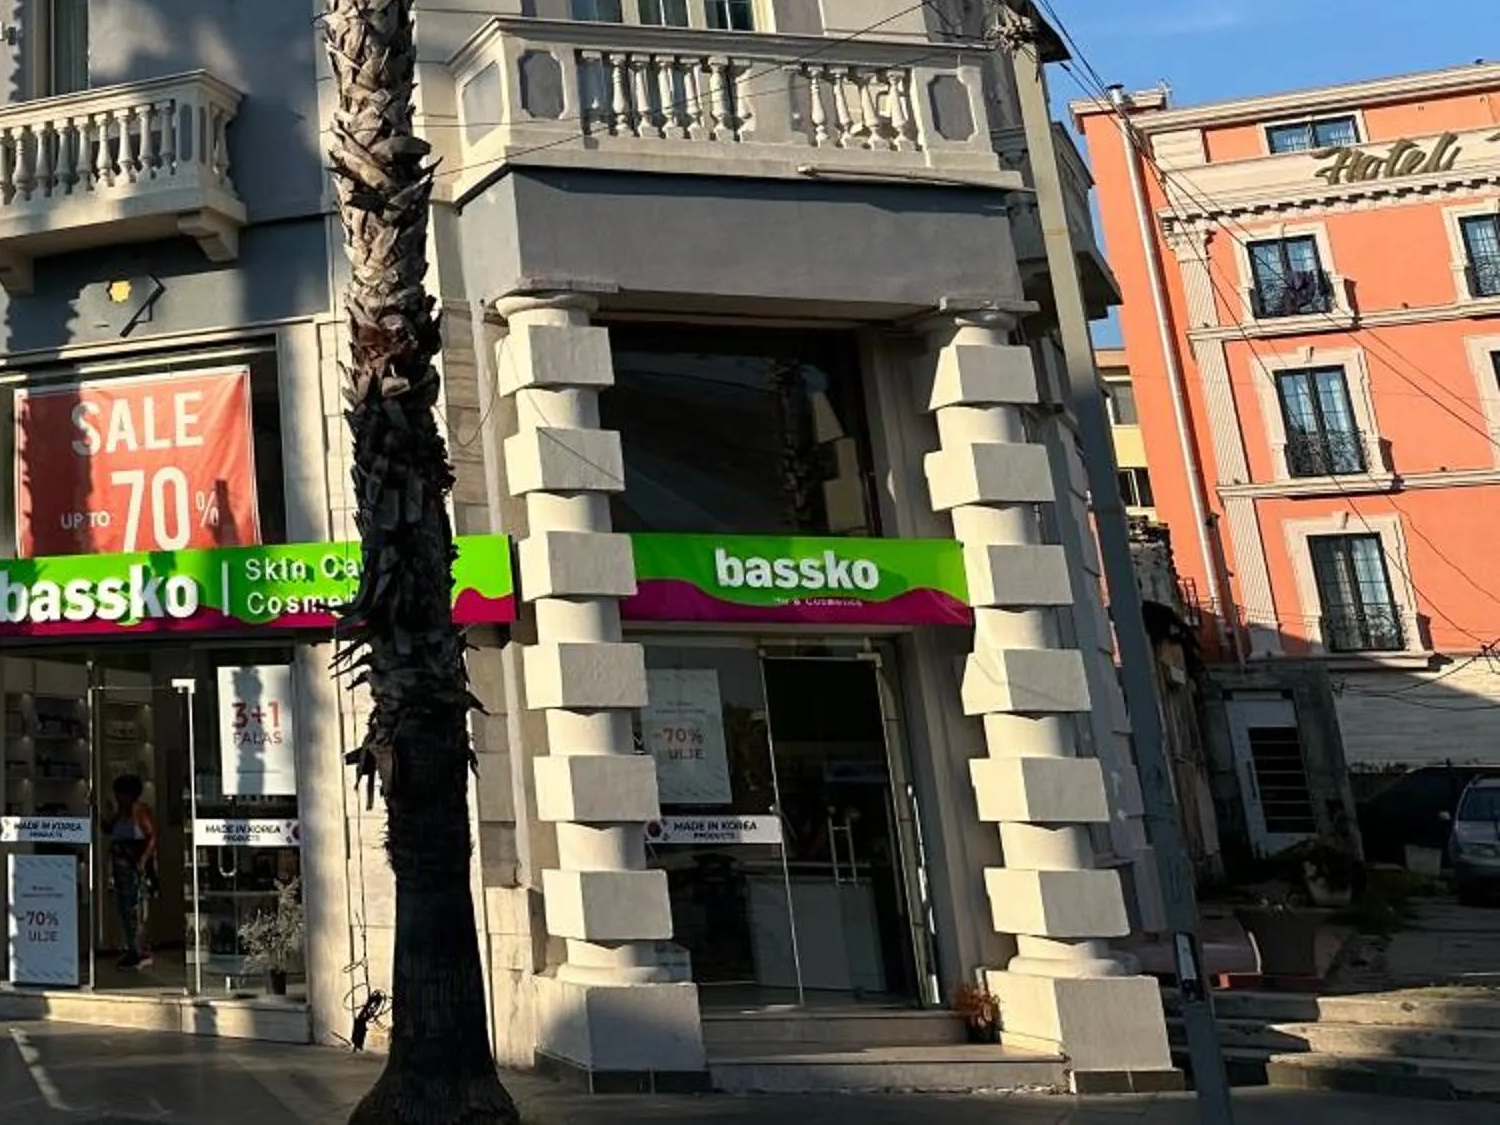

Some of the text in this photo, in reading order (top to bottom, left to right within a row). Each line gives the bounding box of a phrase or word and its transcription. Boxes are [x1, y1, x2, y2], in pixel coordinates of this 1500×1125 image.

[71, 391, 204, 456] SALE
[61, 513, 85, 529] UP
[89, 510, 111, 527] TO
[245, 558, 307, 581] Skin
[321, 554, 364, 578] Ca
[715, 547, 879, 590] bassko
[231, 699, 280, 729] 3+1
[233, 731, 283, 745] FALAS
[653, 728, 705, 743] -70%
[205, 824, 281, 833] MADE IN KOREA
[674, 820, 757, 831] MADE IN KOREA
[16, 911, 59, 926] -70%
